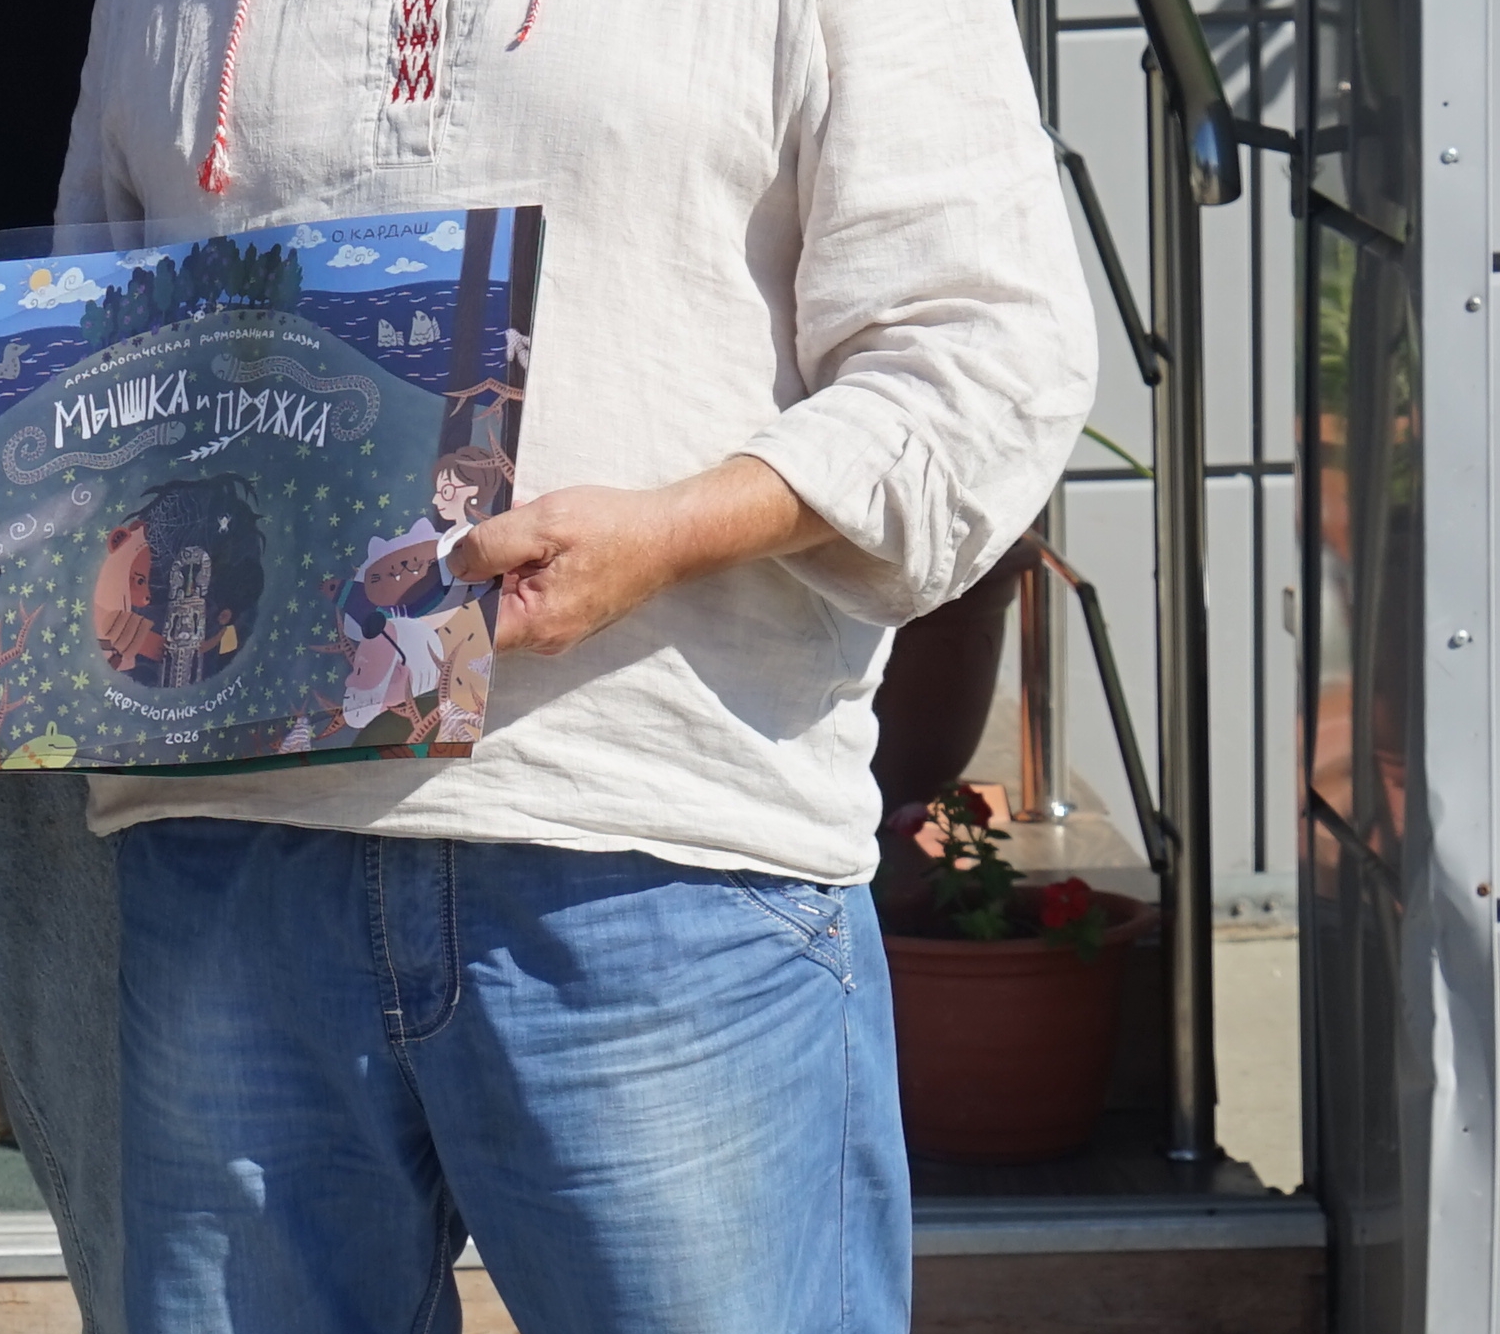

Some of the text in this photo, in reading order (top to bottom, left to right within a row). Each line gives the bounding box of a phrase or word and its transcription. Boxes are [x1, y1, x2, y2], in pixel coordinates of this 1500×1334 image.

[53, 369, 190, 449] МЫШКА
[216, 386, 332, 448] ПРЯЖКА
[165, 730, 200, 745] 2026
